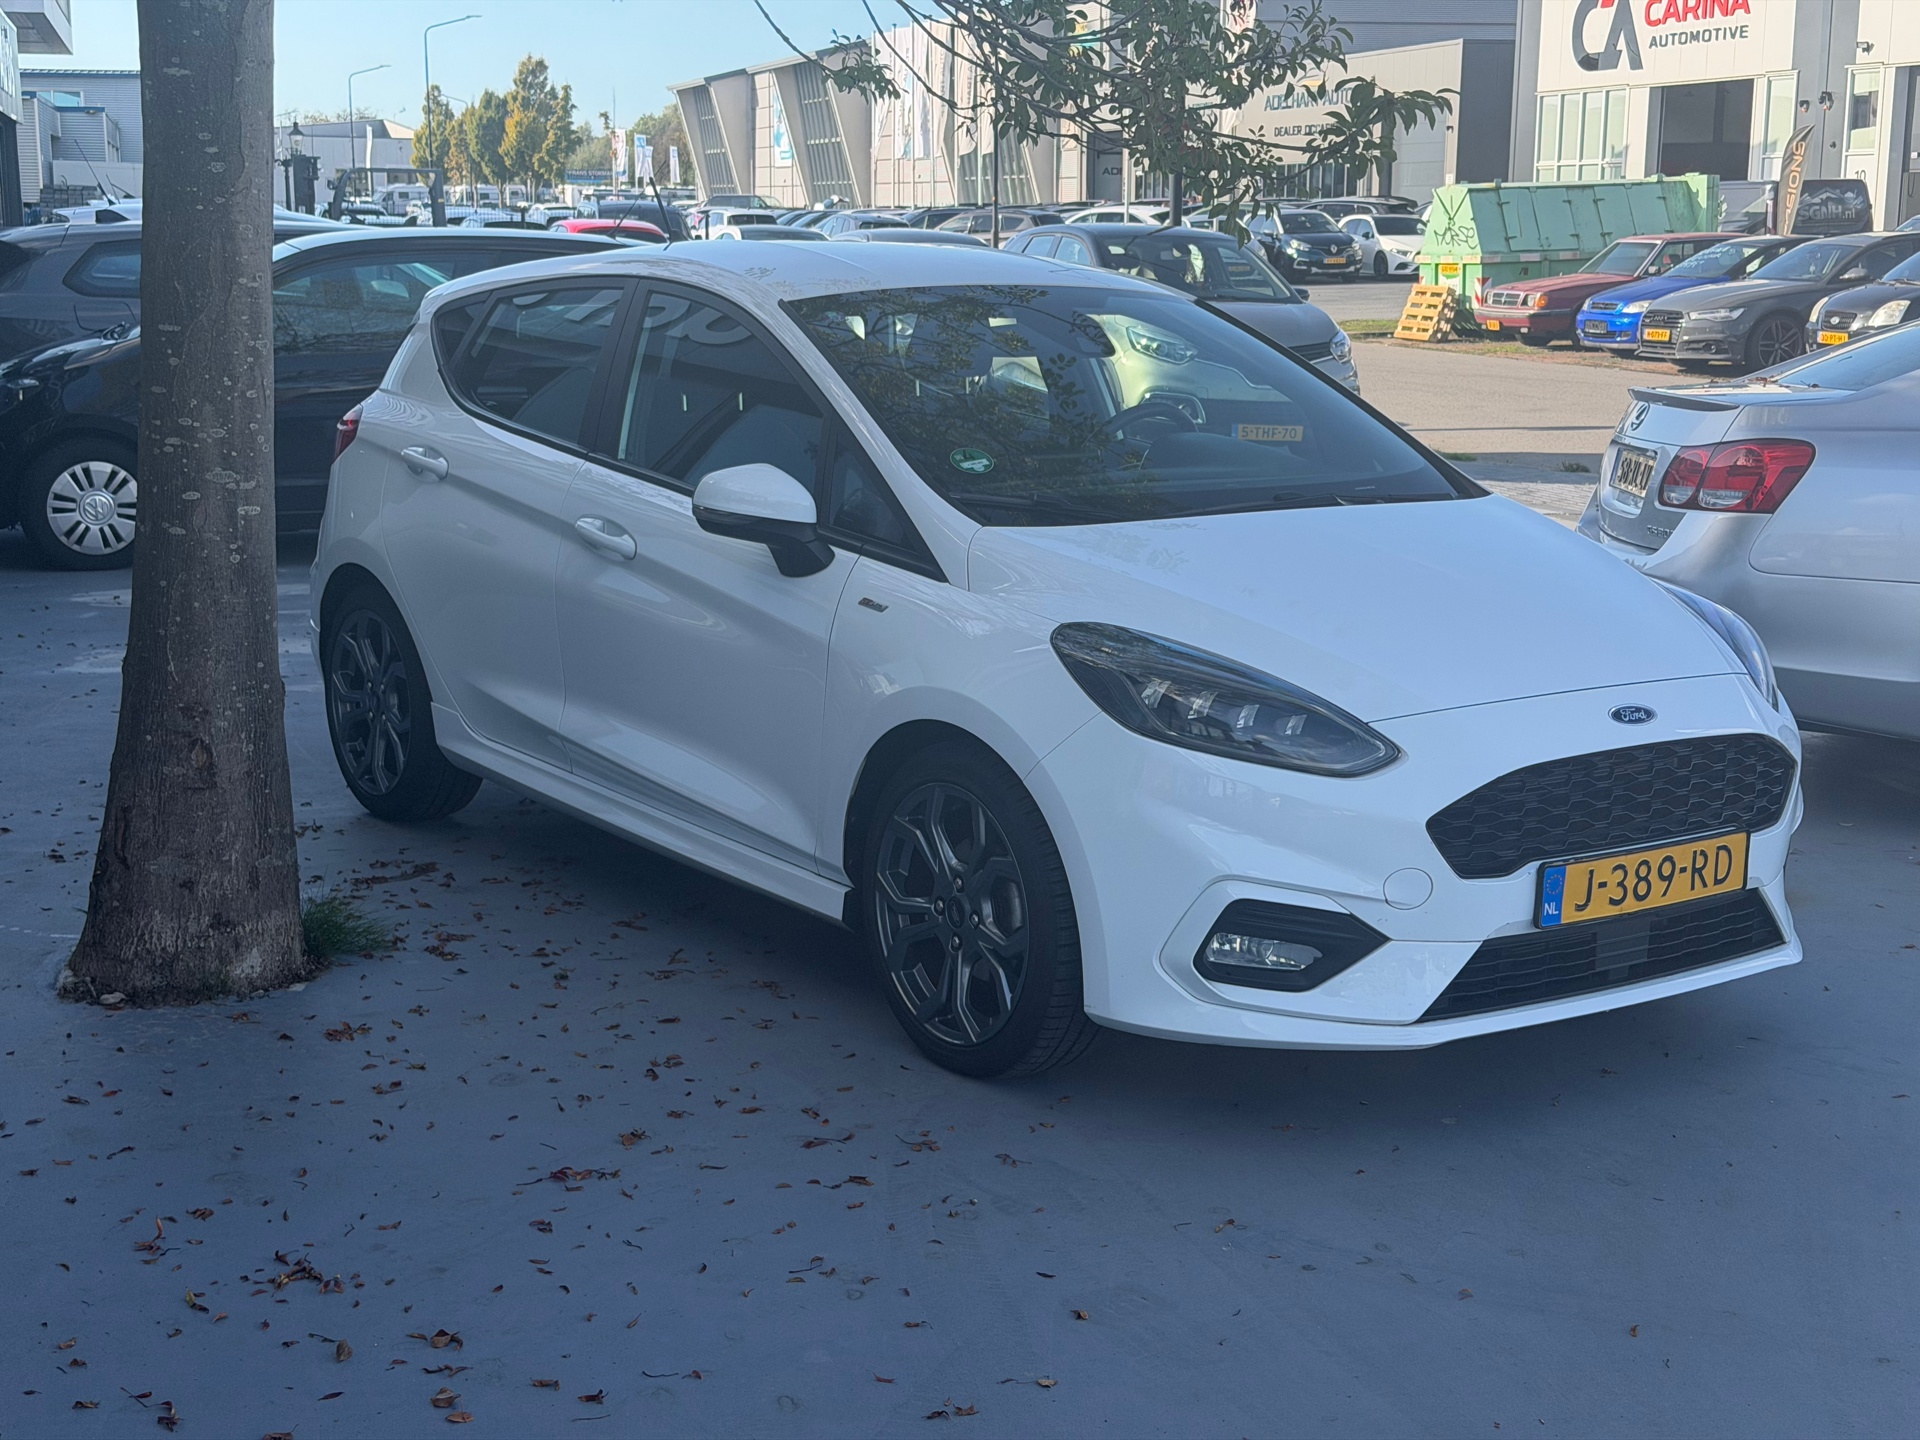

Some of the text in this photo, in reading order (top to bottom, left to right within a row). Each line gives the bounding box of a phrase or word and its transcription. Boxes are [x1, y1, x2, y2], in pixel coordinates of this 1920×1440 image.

[1648, 25, 1750, 49] AUTOMOTIVE
[1274, 125, 1302, 137] DEALER
[1241, 426, 1297, 439] 5-THF-70
[1620, 708, 1648, 721] Ford
[1543, 844, 1733, 916] NL J-389-RD
